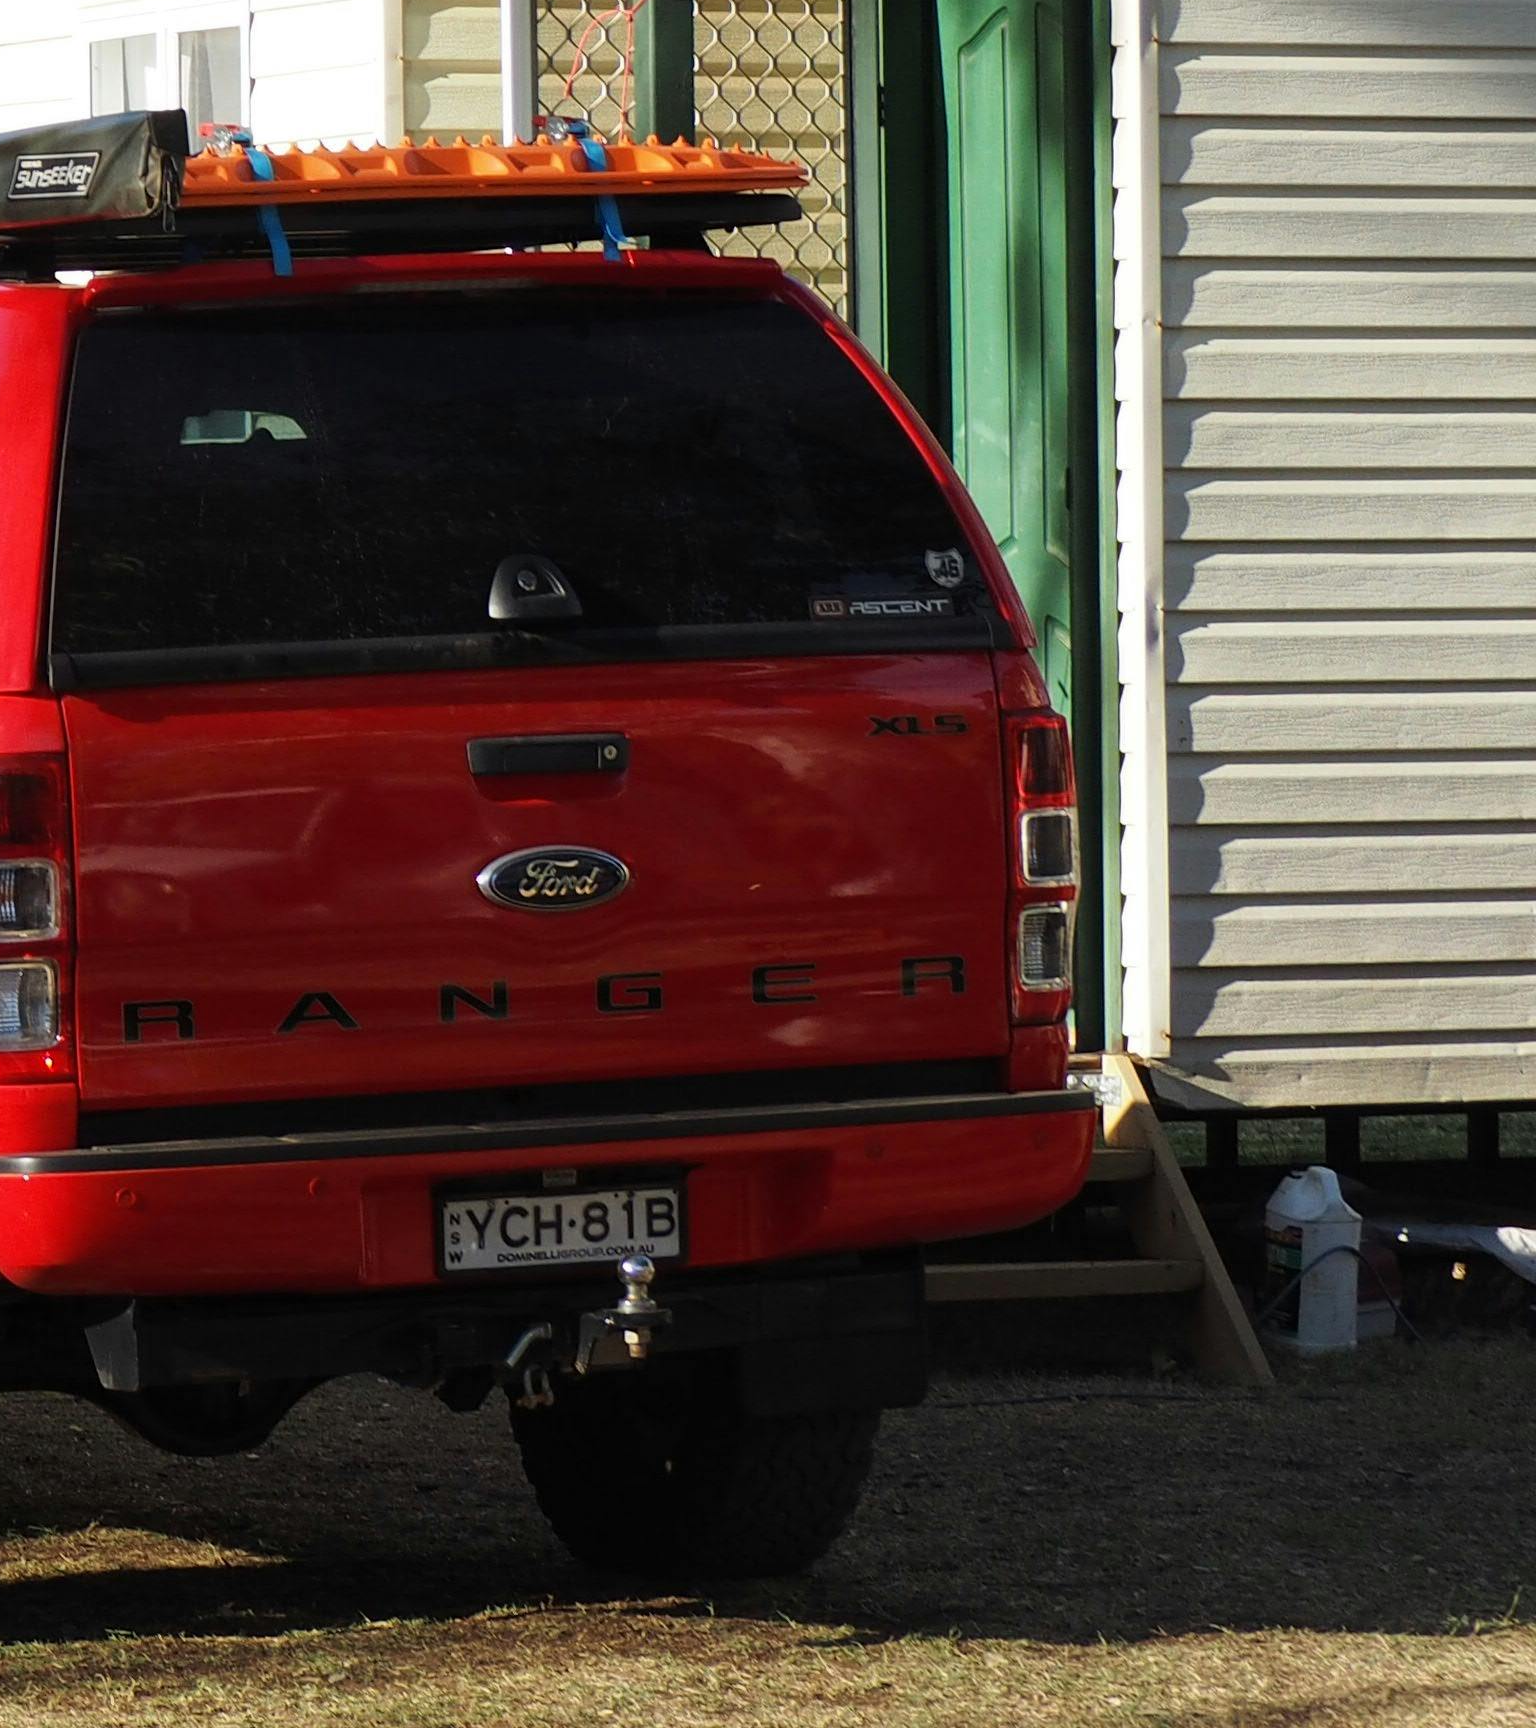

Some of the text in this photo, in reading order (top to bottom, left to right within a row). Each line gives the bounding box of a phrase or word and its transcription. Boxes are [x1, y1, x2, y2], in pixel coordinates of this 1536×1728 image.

[849, 598, 949, 615] ASCENT
[868, 715, 970, 736] XLS
[519, 859, 601, 897] Ford
[123, 954, 966, 1042] RANGER
[448, 1212, 464, 1265] NSW
